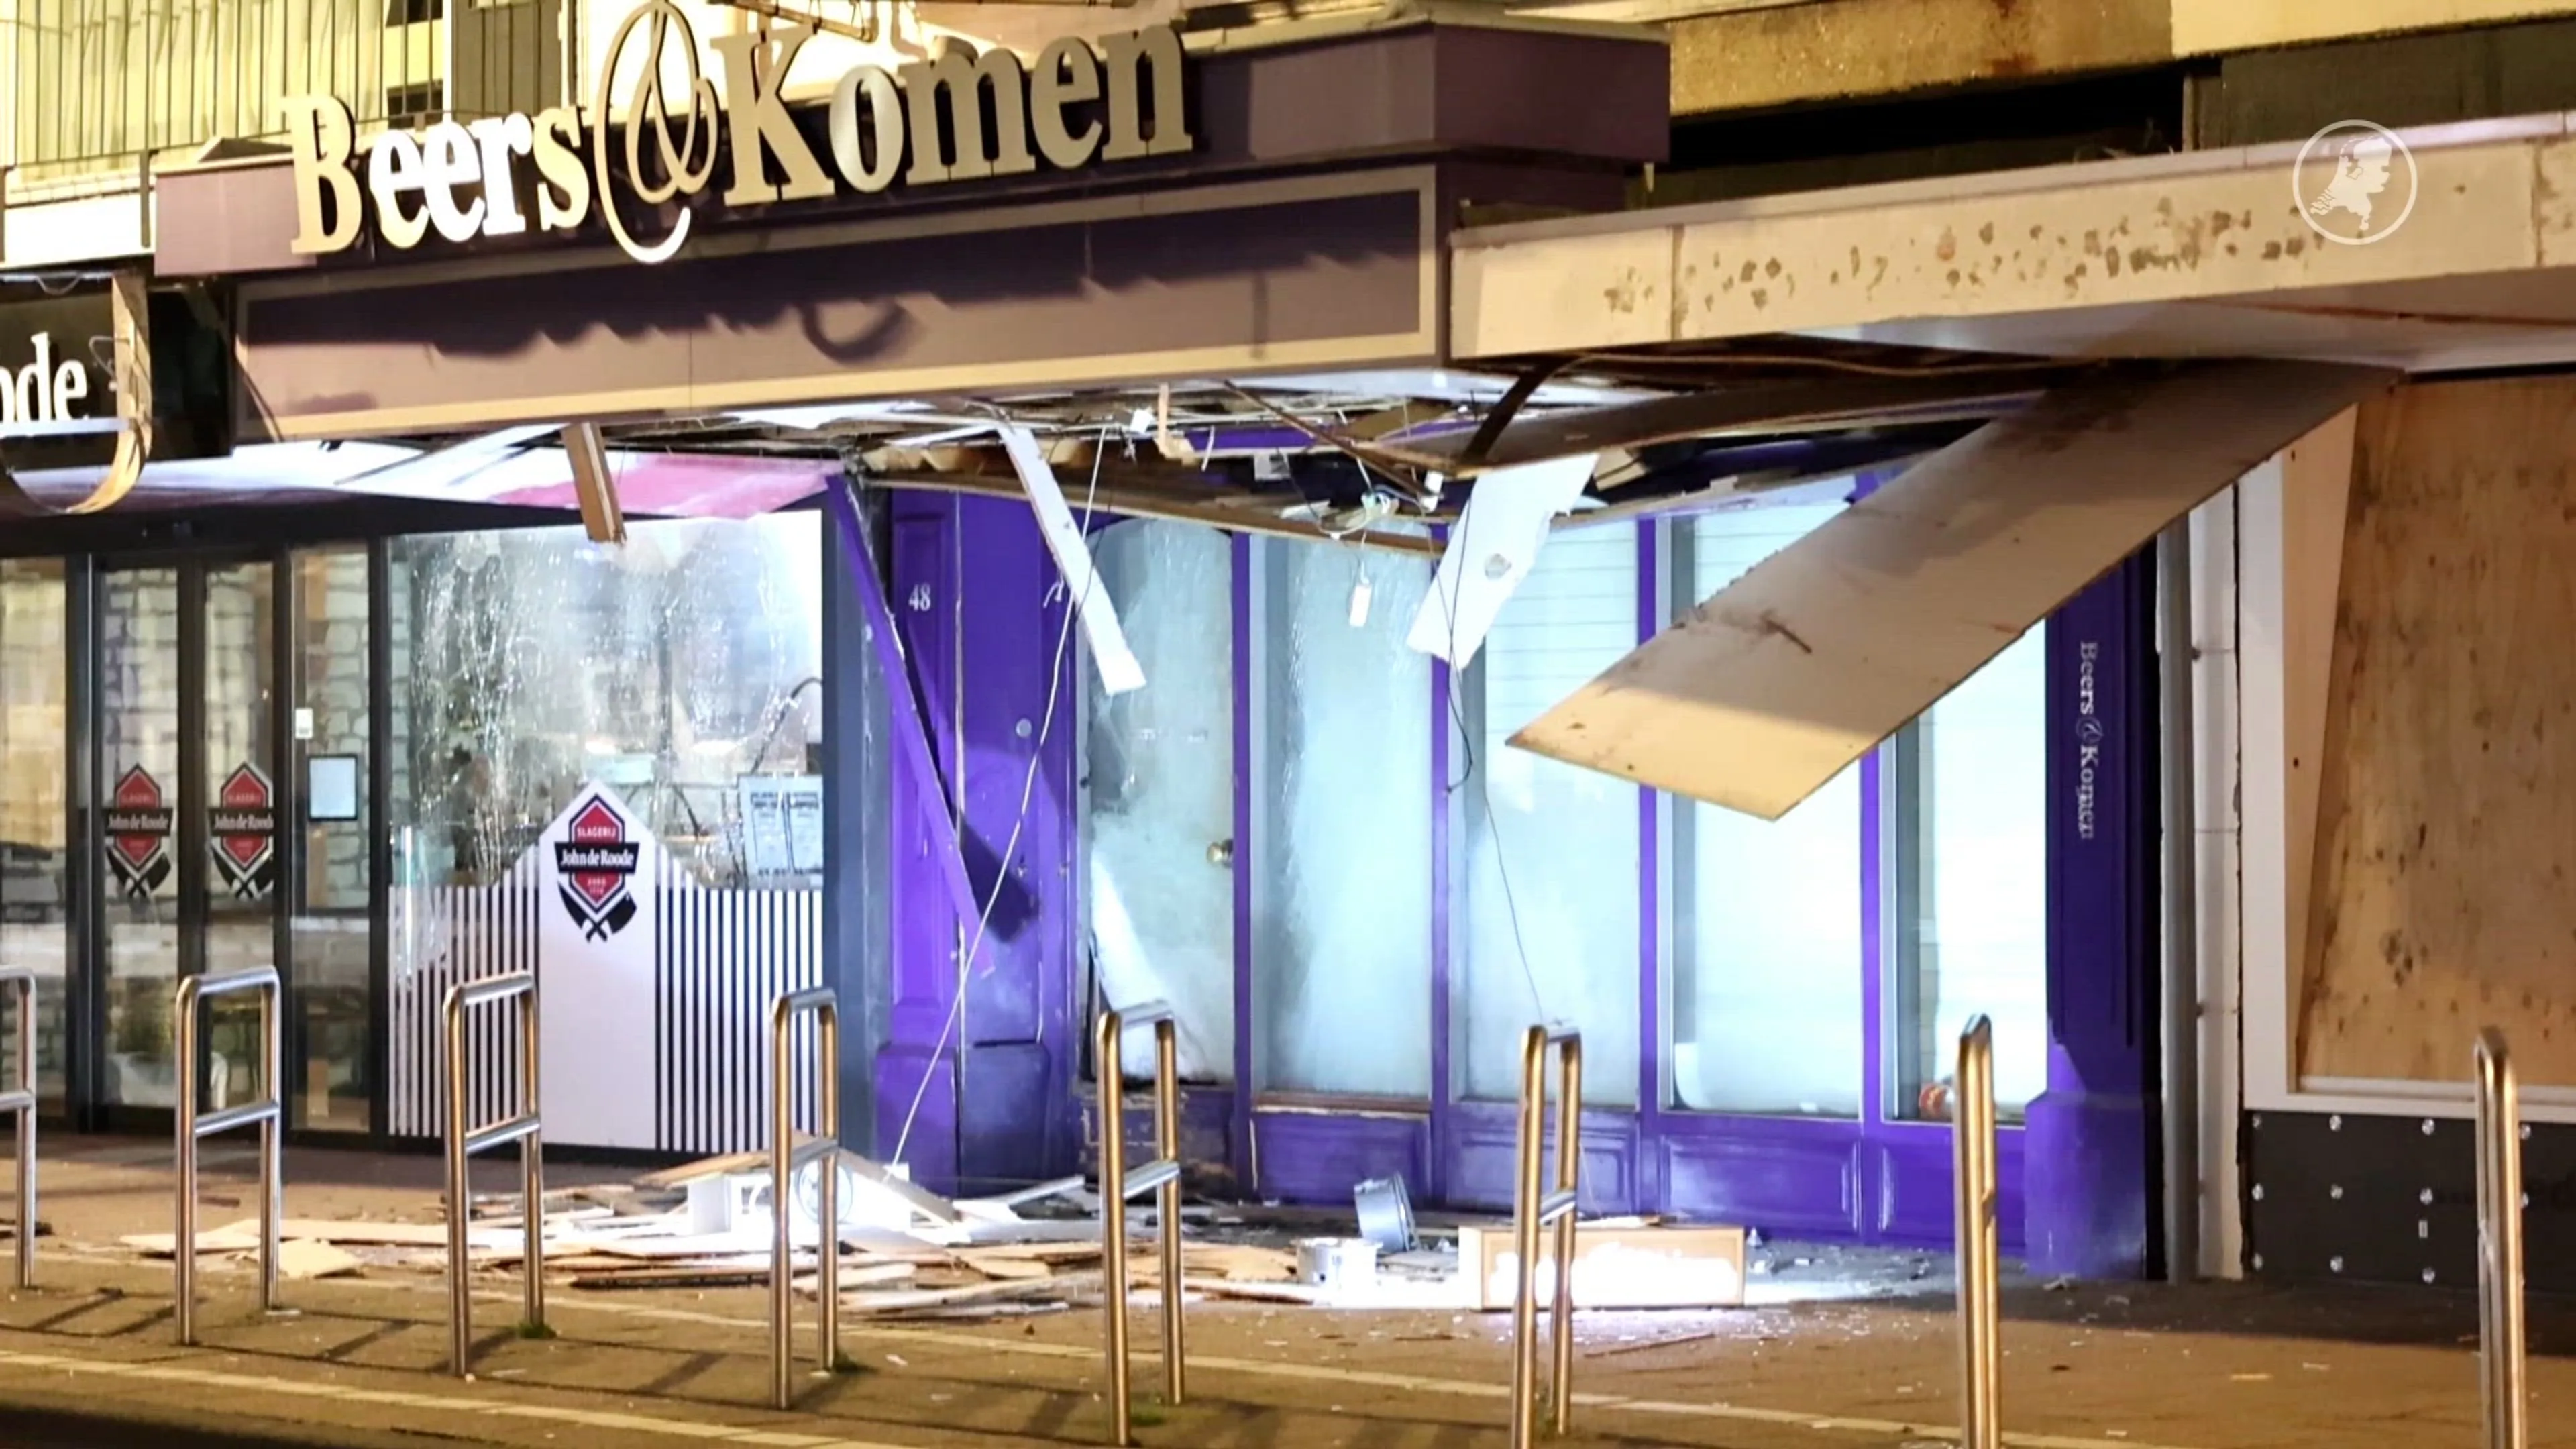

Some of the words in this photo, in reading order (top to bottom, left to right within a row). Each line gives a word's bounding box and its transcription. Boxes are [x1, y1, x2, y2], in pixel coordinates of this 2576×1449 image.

[280, 95, 590, 254] Beers
[710, 23, 1193, 207] Komen
[908, 583, 932, 612] 48
[2080, 641, 2098, 715] Beers
[560, 847, 587, 867] John
[587, 847, 600, 867] de
[600, 847, 635, 867] Roode
